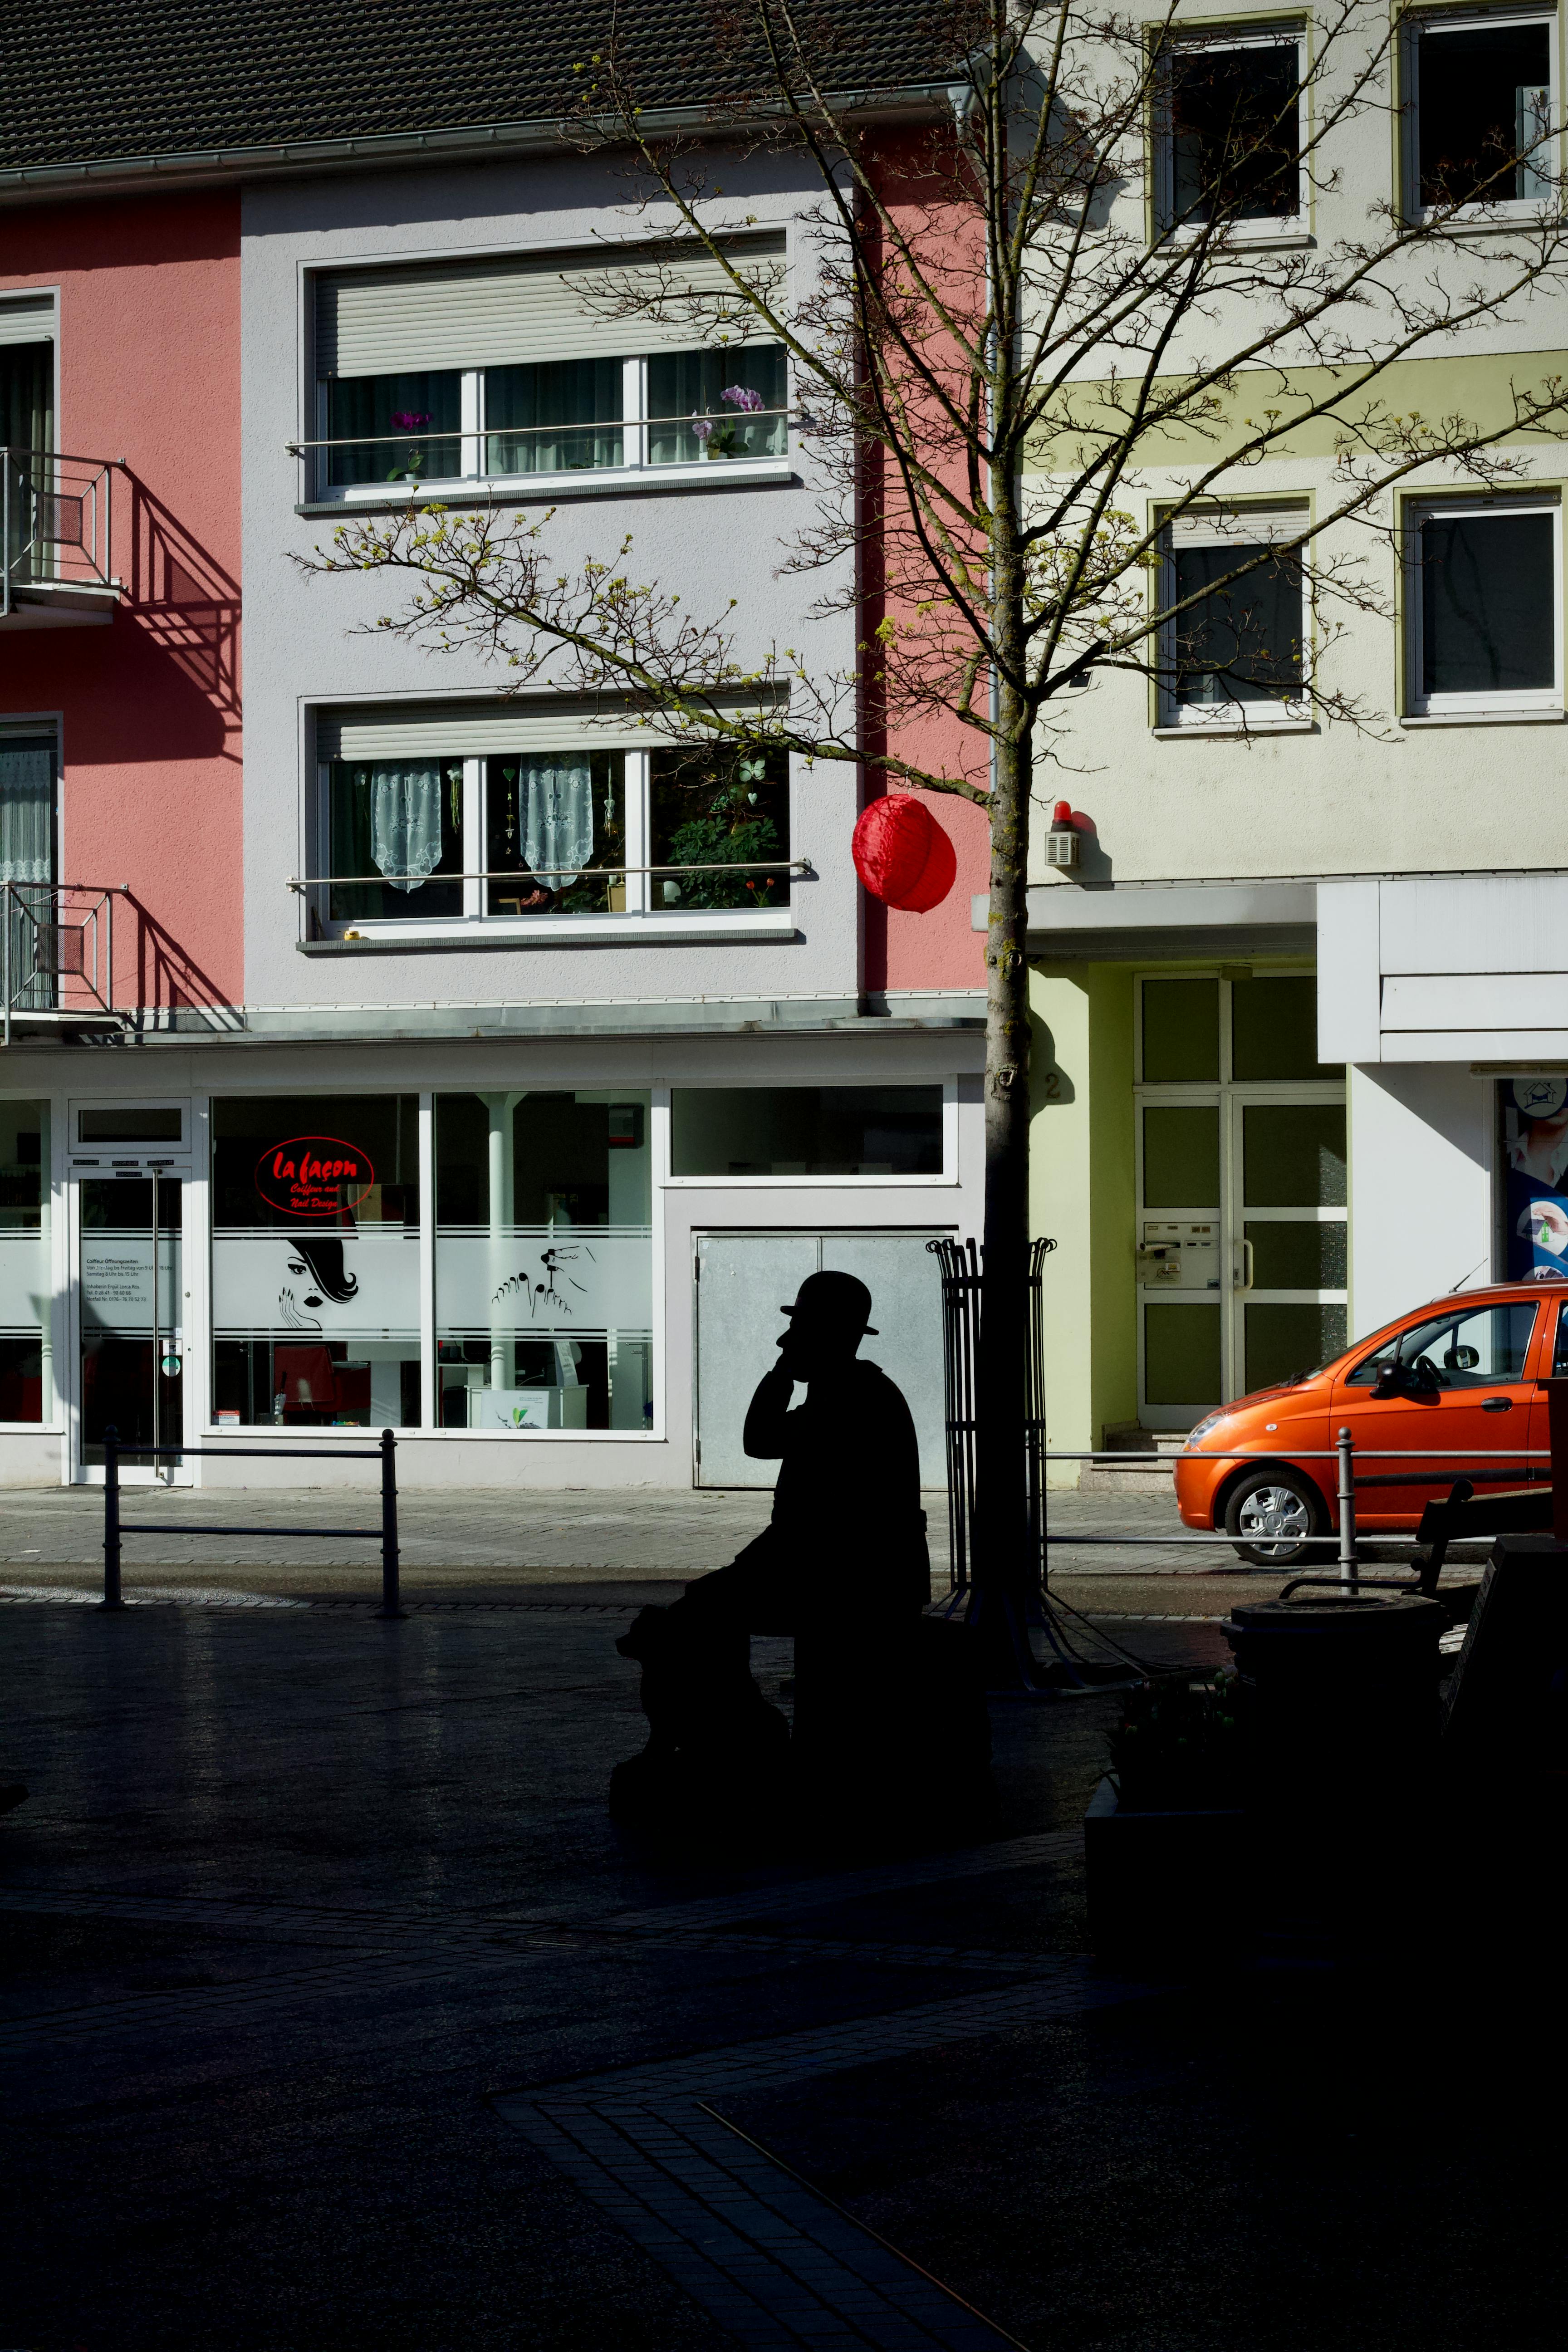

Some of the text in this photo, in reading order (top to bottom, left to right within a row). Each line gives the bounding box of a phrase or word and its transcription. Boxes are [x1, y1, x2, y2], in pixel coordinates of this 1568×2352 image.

[1045, 1073, 1061, 1099] 2
[299, 1151, 357, 1184] façon
[290, 1183, 340, 1196] Coiffeur and
[290, 1198, 338, 1210] Nail Design
